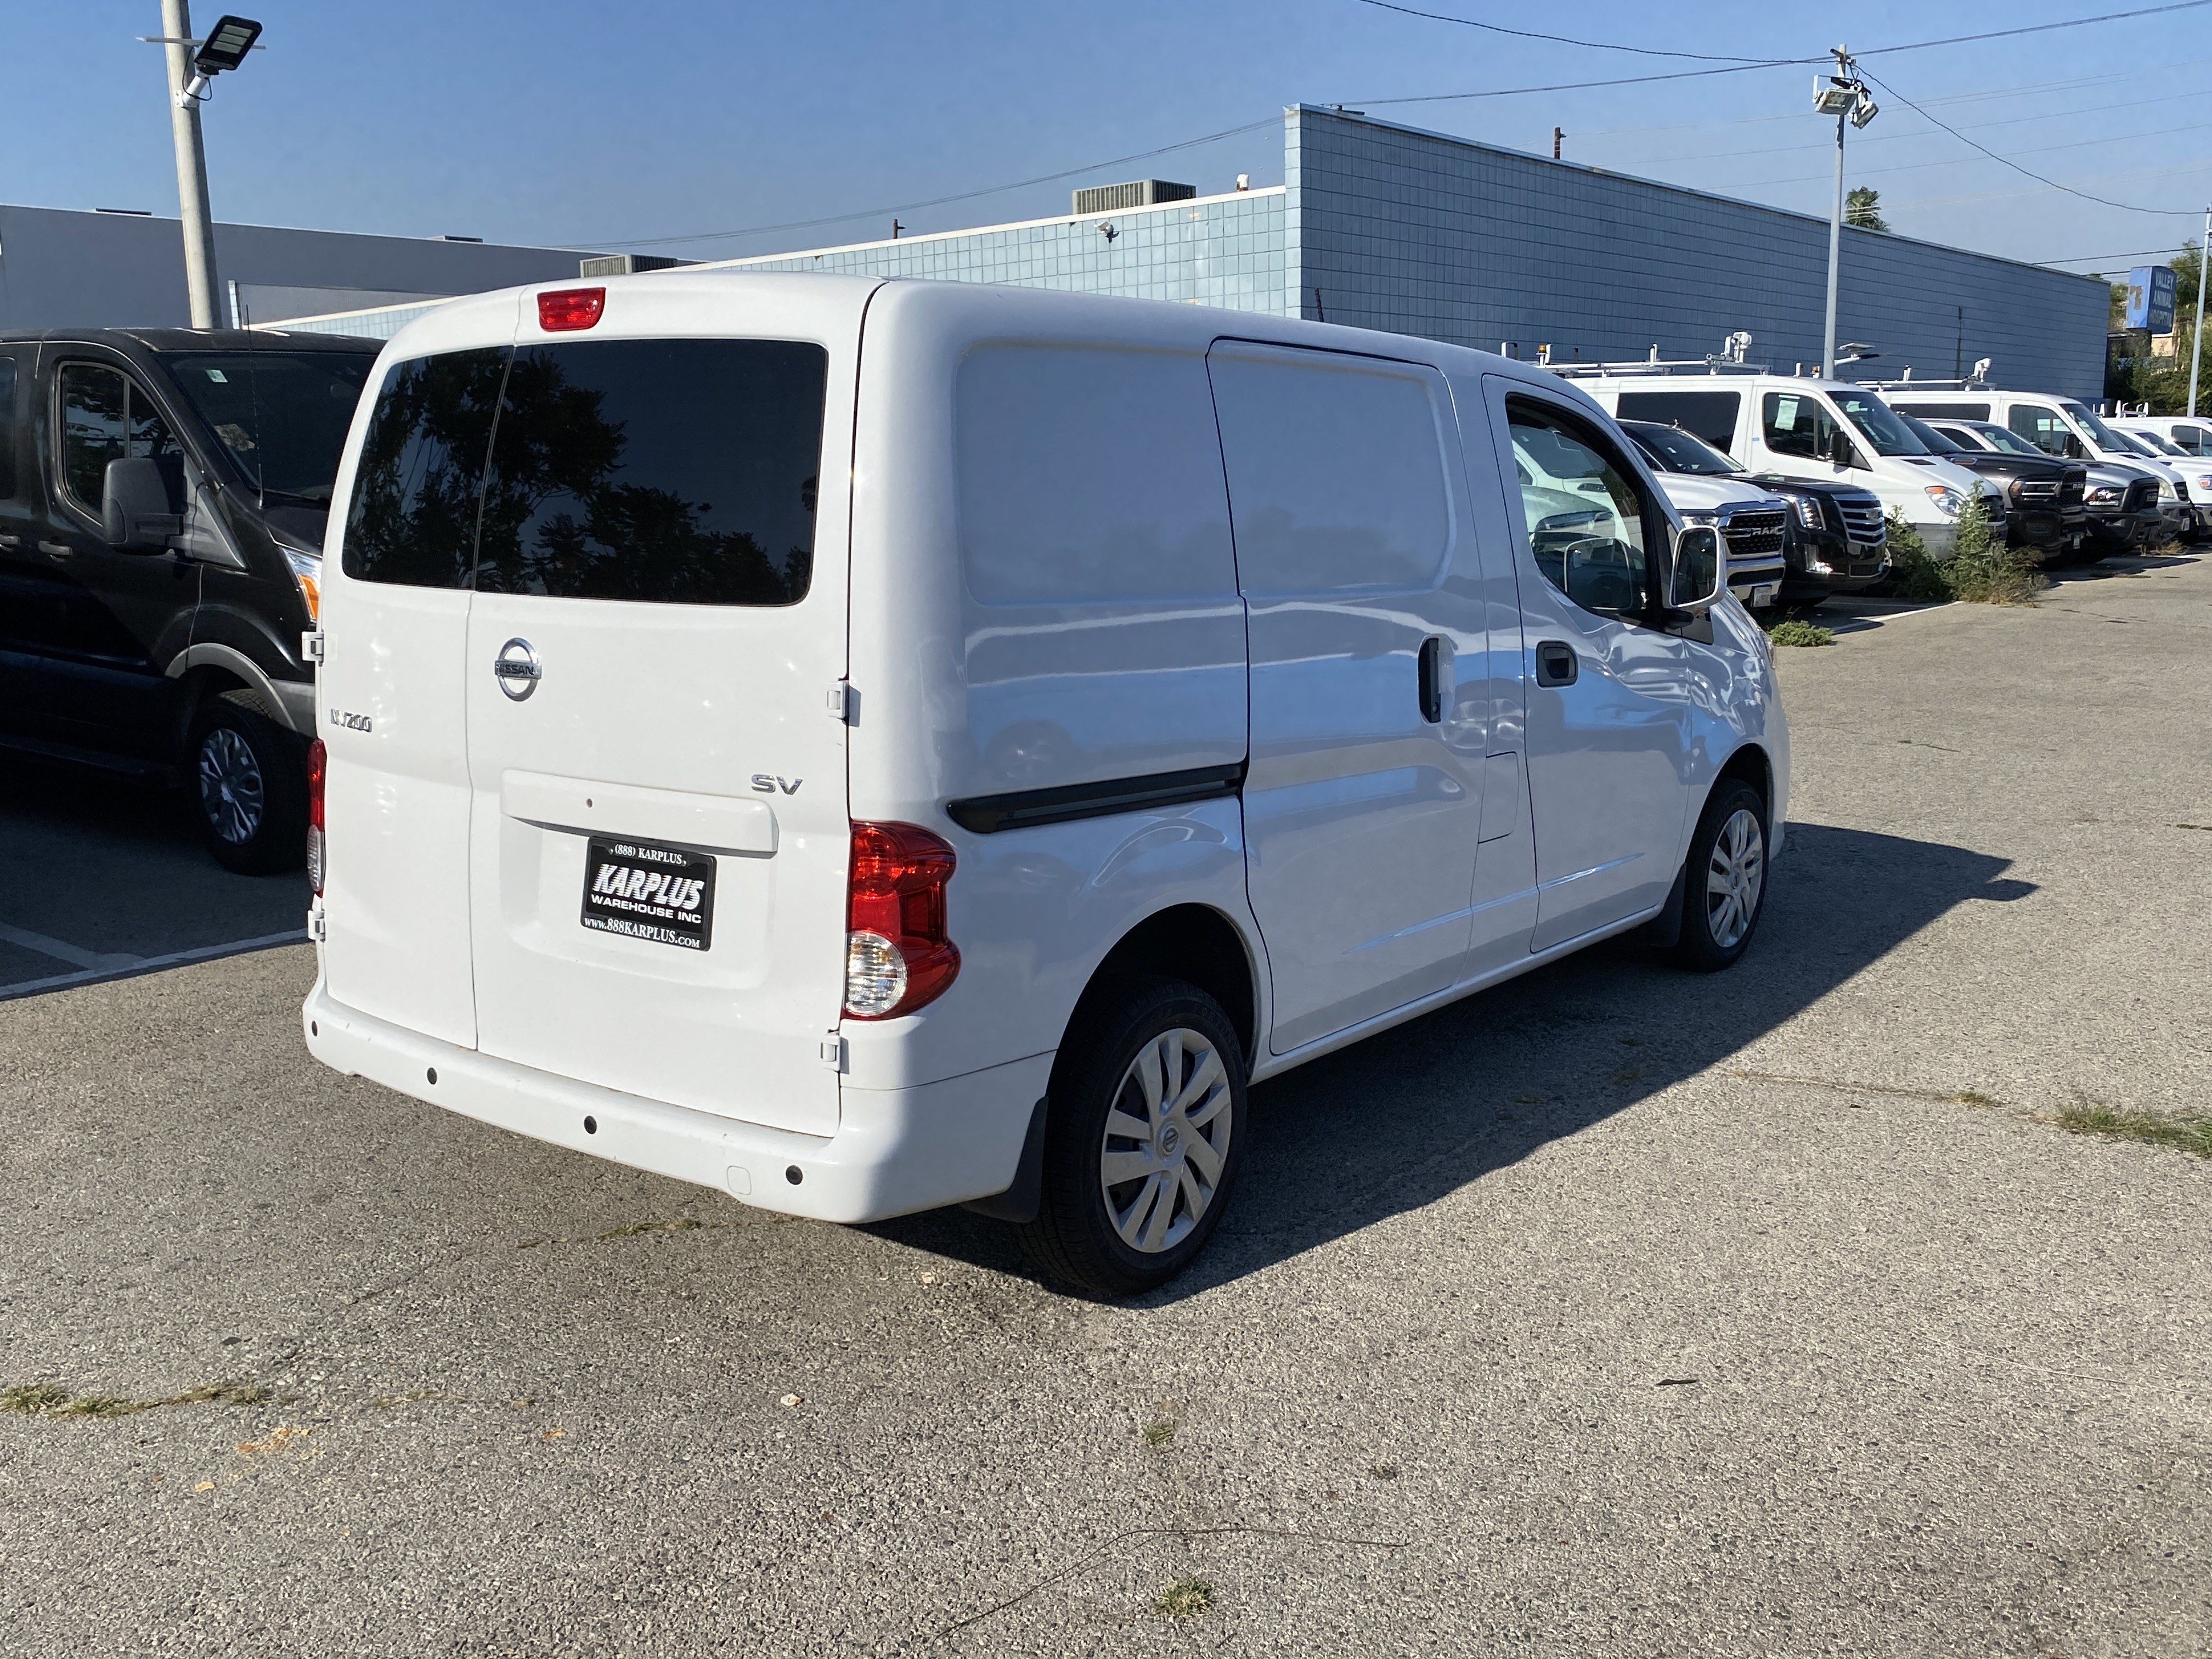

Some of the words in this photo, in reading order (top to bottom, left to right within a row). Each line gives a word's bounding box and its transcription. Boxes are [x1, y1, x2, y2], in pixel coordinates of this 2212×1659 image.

[2155, 271, 2174, 290] VALLEY
[495, 662, 538, 676] NISSAN
[330, 708, 372, 732] NV200
[751, 774, 803, 795] SV
[614, 844, 636, 857] (888)
[638, 848, 682, 865] KARPLUS
[591, 863, 705, 910] KARPLUS
[591, 894, 674, 919] WAREHOUSE
[678, 910, 702, 924] INC
